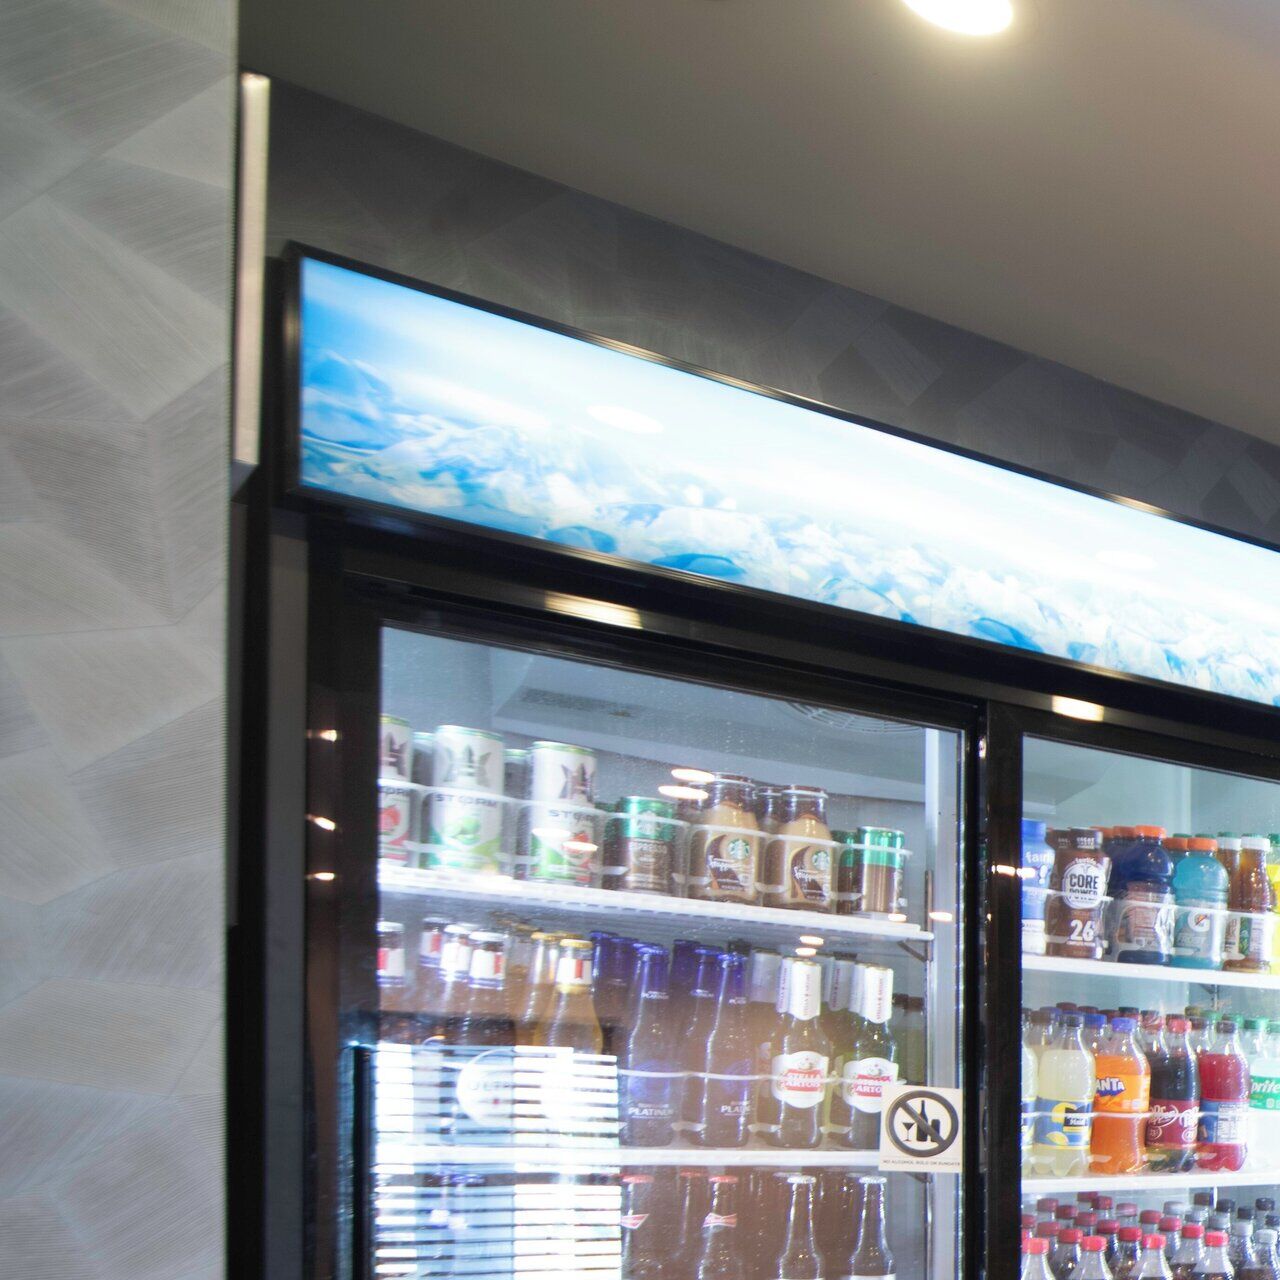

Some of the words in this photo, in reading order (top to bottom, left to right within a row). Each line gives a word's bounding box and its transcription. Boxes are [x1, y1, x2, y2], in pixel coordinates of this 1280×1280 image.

[1069, 873, 1099, 890] CORE
[856, 1083, 882, 1094] ARTO
[1096, 1076, 1125, 1093] ANTA
